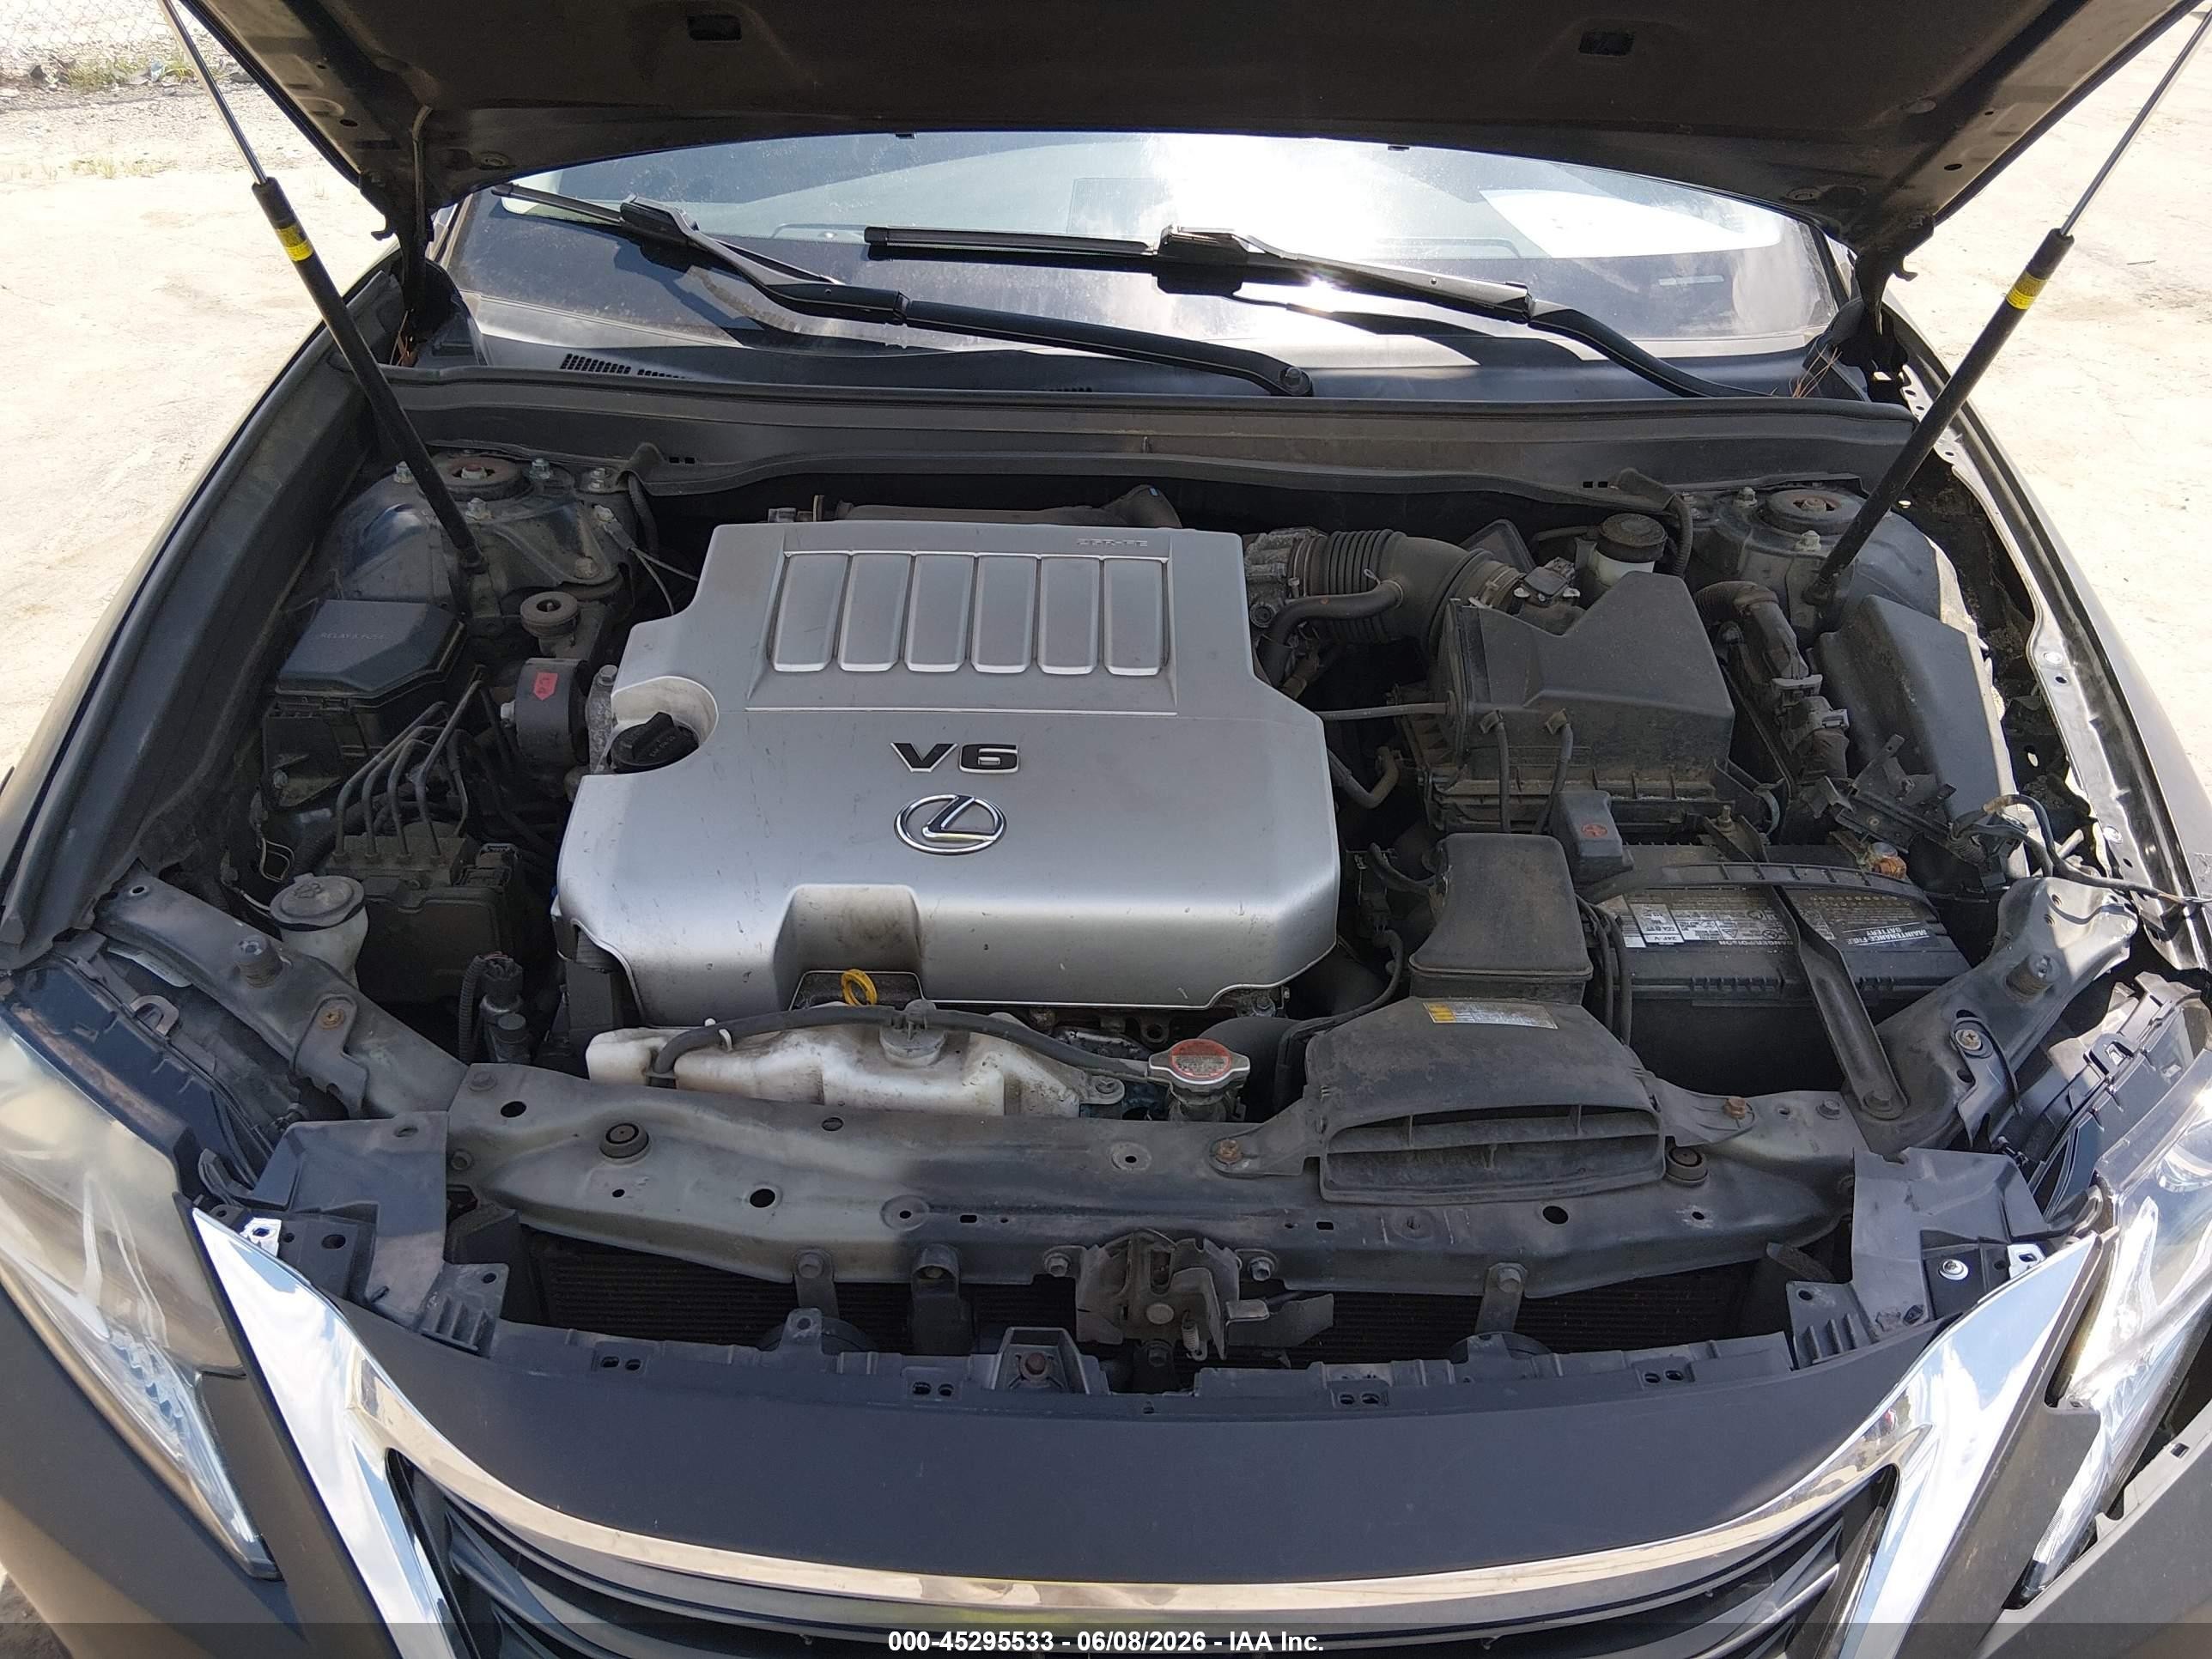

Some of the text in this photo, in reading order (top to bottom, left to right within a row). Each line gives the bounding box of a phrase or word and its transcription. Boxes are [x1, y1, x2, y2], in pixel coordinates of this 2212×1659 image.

[890, 742, 1018, 774] V6
[1847, 929, 1928, 945] MAINTENANCE-FREE
[1866, 927, 1903, 937] BATTERY
